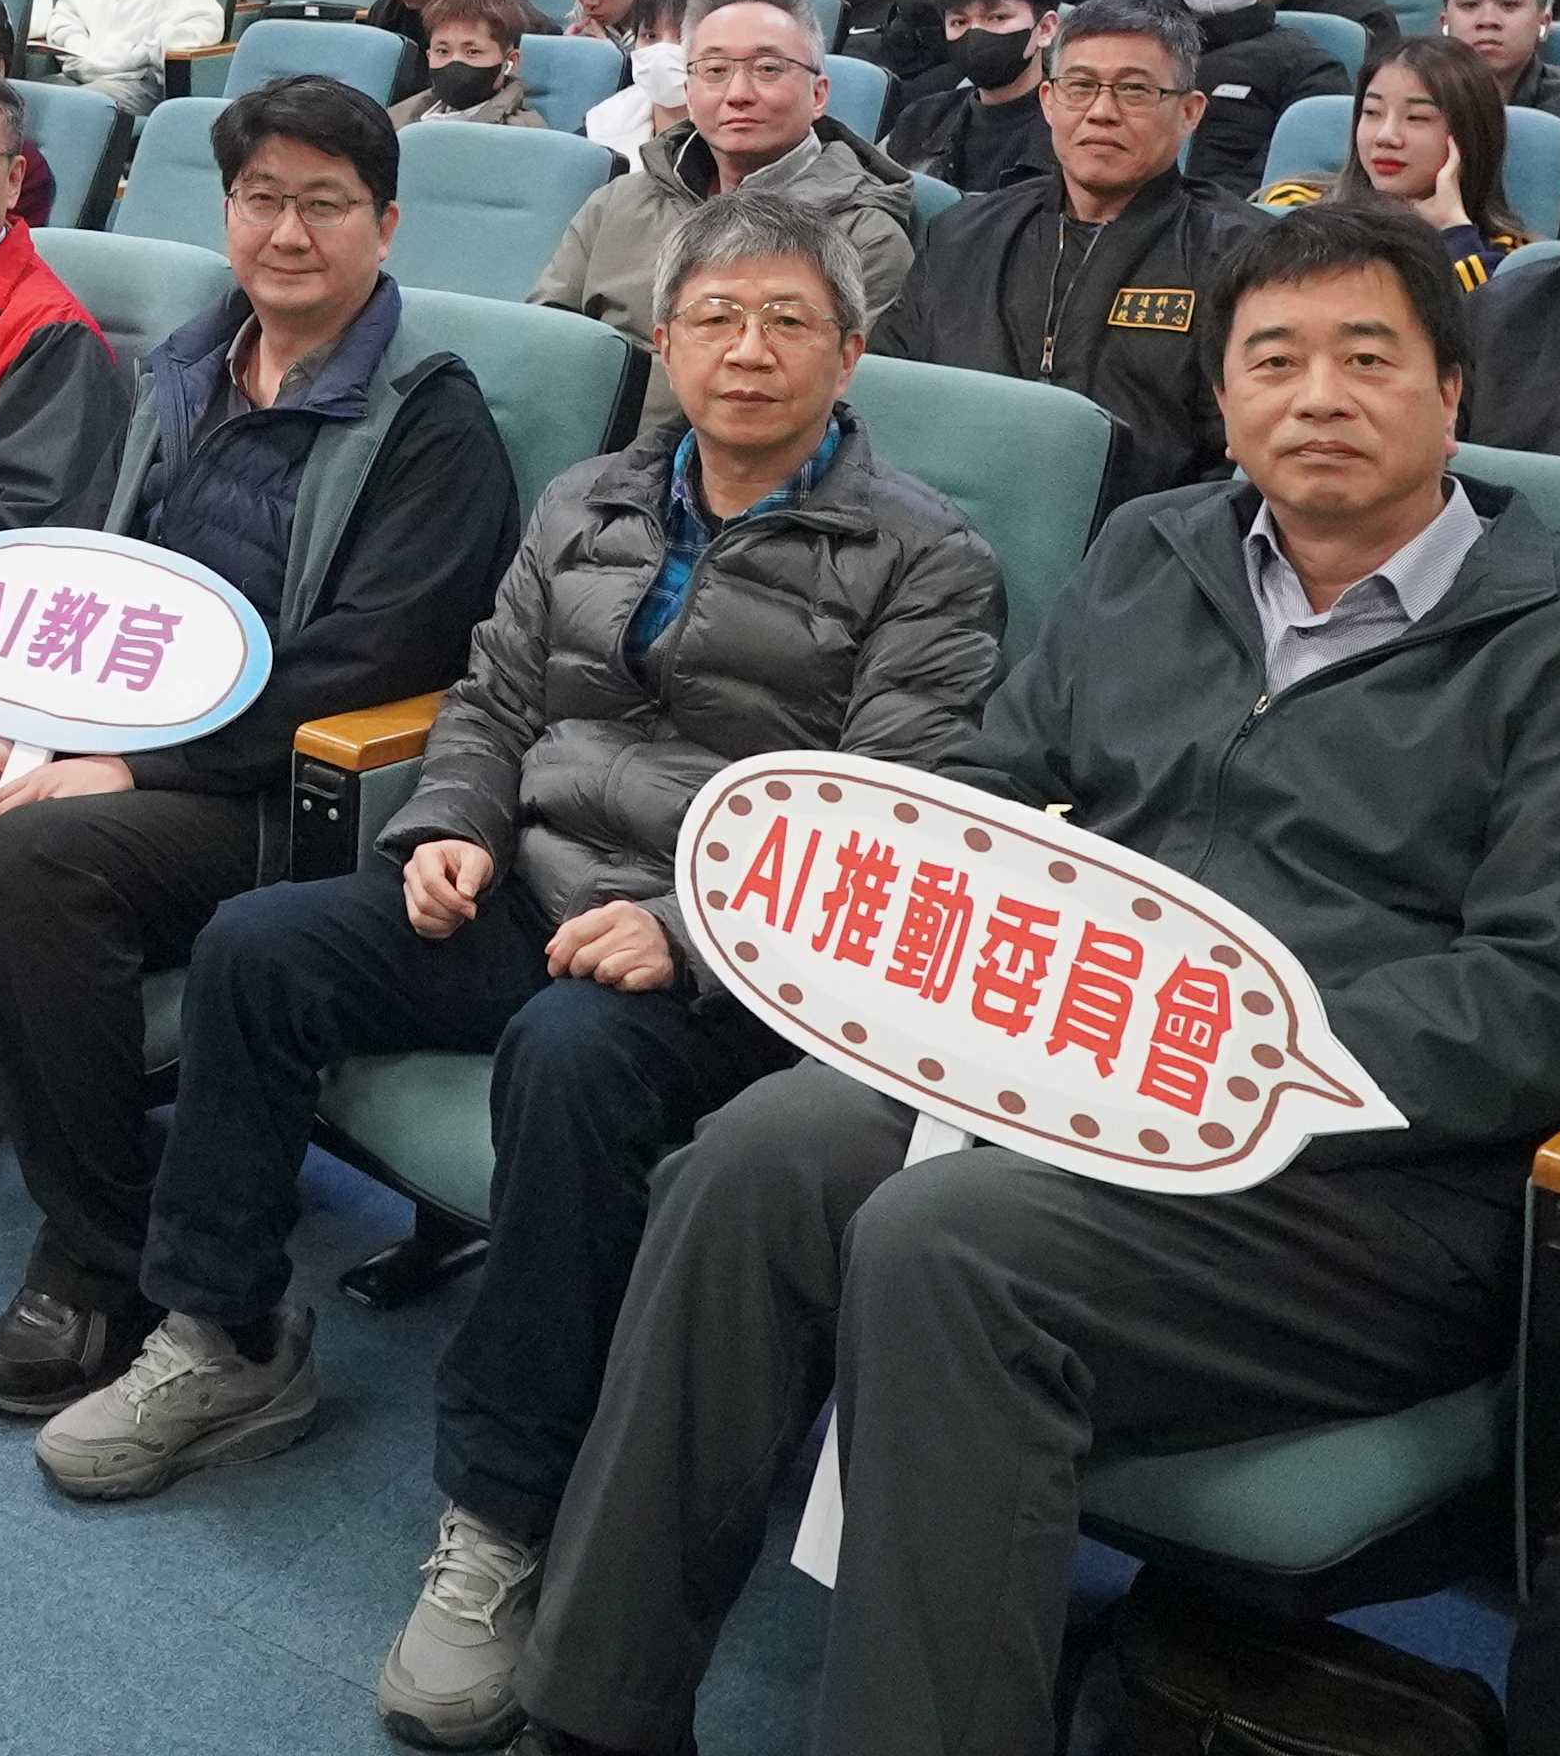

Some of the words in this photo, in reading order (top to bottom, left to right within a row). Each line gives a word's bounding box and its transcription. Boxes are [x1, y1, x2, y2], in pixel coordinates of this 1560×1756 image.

[730, 815, 1234, 1118] AI推動委員會
